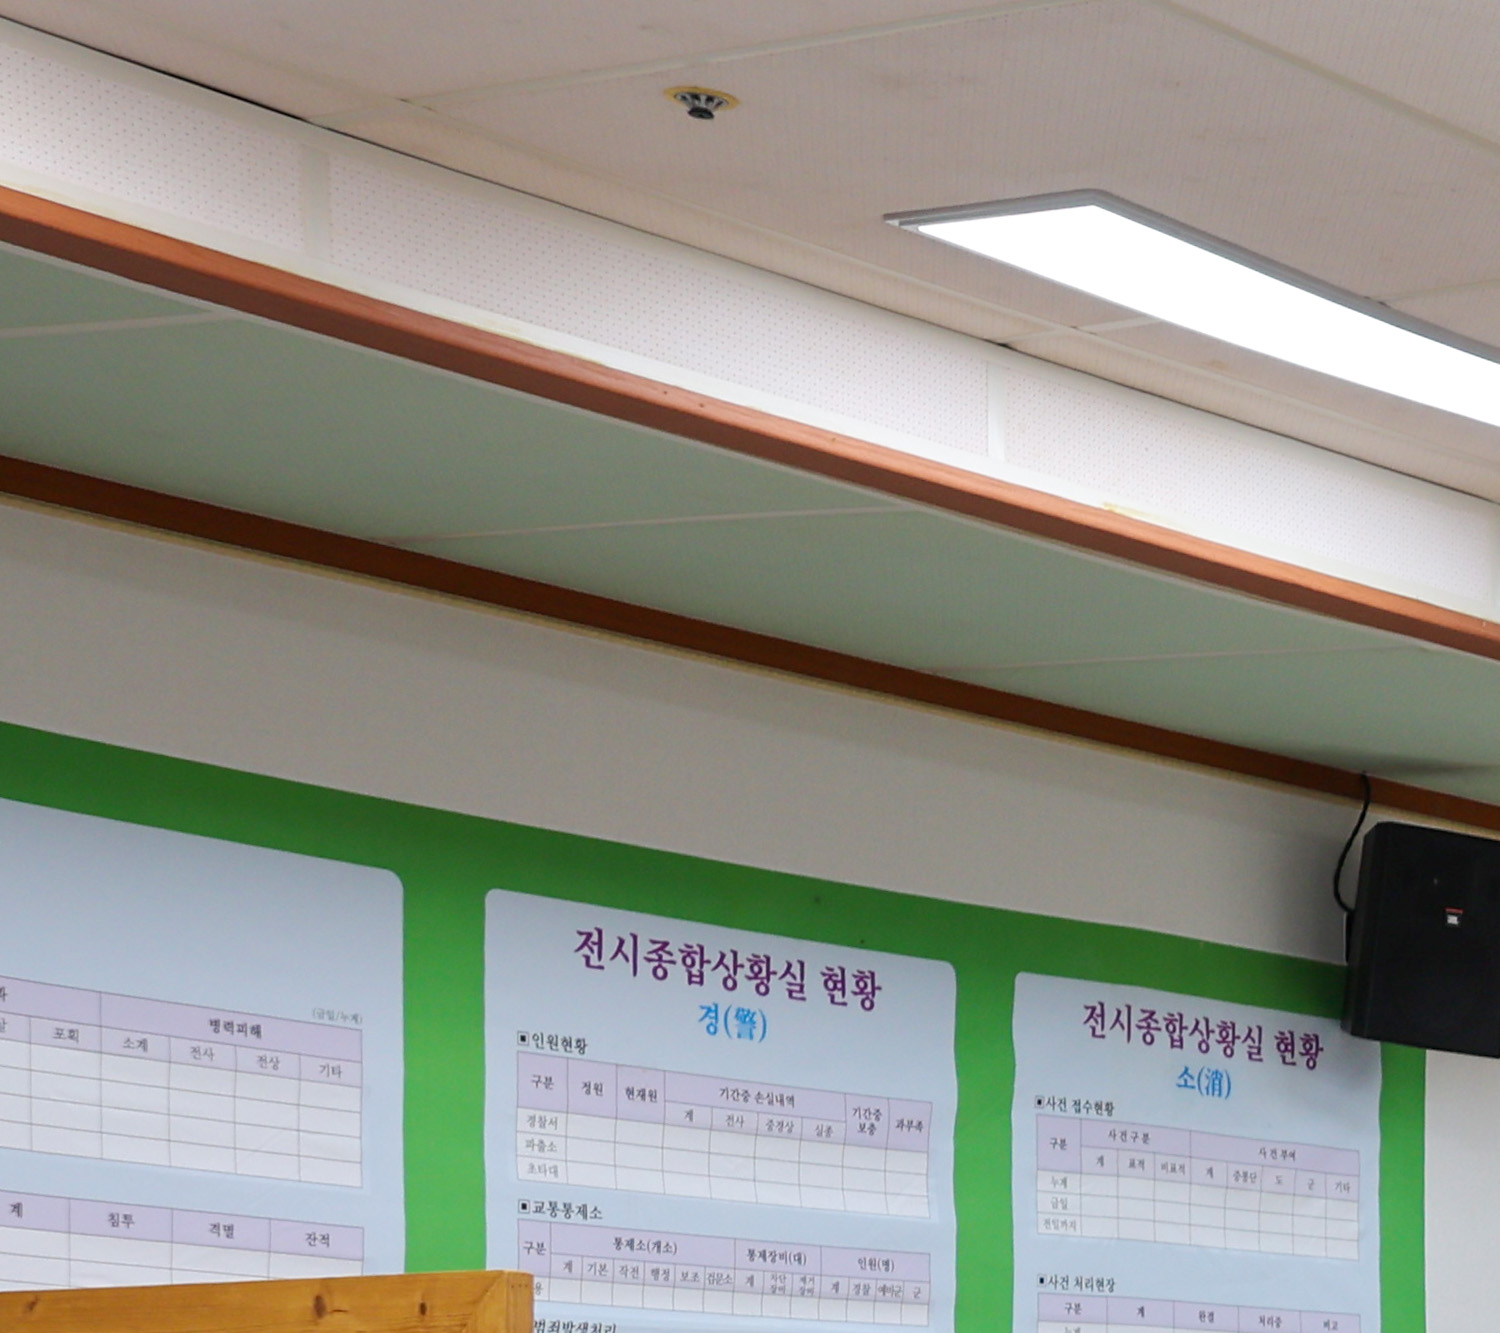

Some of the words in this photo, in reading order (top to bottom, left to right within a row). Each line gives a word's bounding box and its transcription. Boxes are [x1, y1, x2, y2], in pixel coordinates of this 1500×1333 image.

[574, 927, 807, 1002] 전시종합상황실
[819, 964, 883, 1012] 현황
[52, 1027, 81, 1044] 포획
[208, 1018, 263, 1040] 병력피해
[1083, 1001, 1263, 1062] 전시종합상황실
[1274, 1030, 1324, 1071] 현황
[122, 1037, 149, 1053] 소계
[531, 1032, 588, 1056] 인원현황
[256, 1054, 281, 1071] 전상
[318, 1062, 343, 1079] 기타
[530, 1074, 555, 1091] 구분
[580, 1081, 604, 1097] 정원
[1176, 1065, 1232, 1100] 소(消)
[624, 1086, 658, 1103] 현재원
[719, 1086, 751, 1104] 기간중
[753, 1091, 796, 1110] 손실내역
[851, 1106, 883, 1123] 기간중
[1046, 1095, 1068, 1113] 사건
[1071, 1098, 1115, 1117] 접수현황
[526, 1113, 559, 1131] 경찰서
[1049, 1137, 1068, 1151] 구분
[9, 1202, 24, 1219] 계
[531, 1200, 603, 1221] 교통통제소
[106, 1212, 136, 1230] 침투
[304, 1231, 332, 1249] 잔적
[523, 1240, 547, 1256] 구분
[612, 1236, 678, 1256] 통제소(개소)
[746, 1247, 807, 1265] 통제장비(대)
[586, 1261, 609, 1277] 기본
[857, 1257, 895, 1274] 인원(명)
[679, 1271, 700, 1283] 보조
[1048, 1274, 1070, 1291] 사건
[1064, 1302, 1083, 1315] 구분
